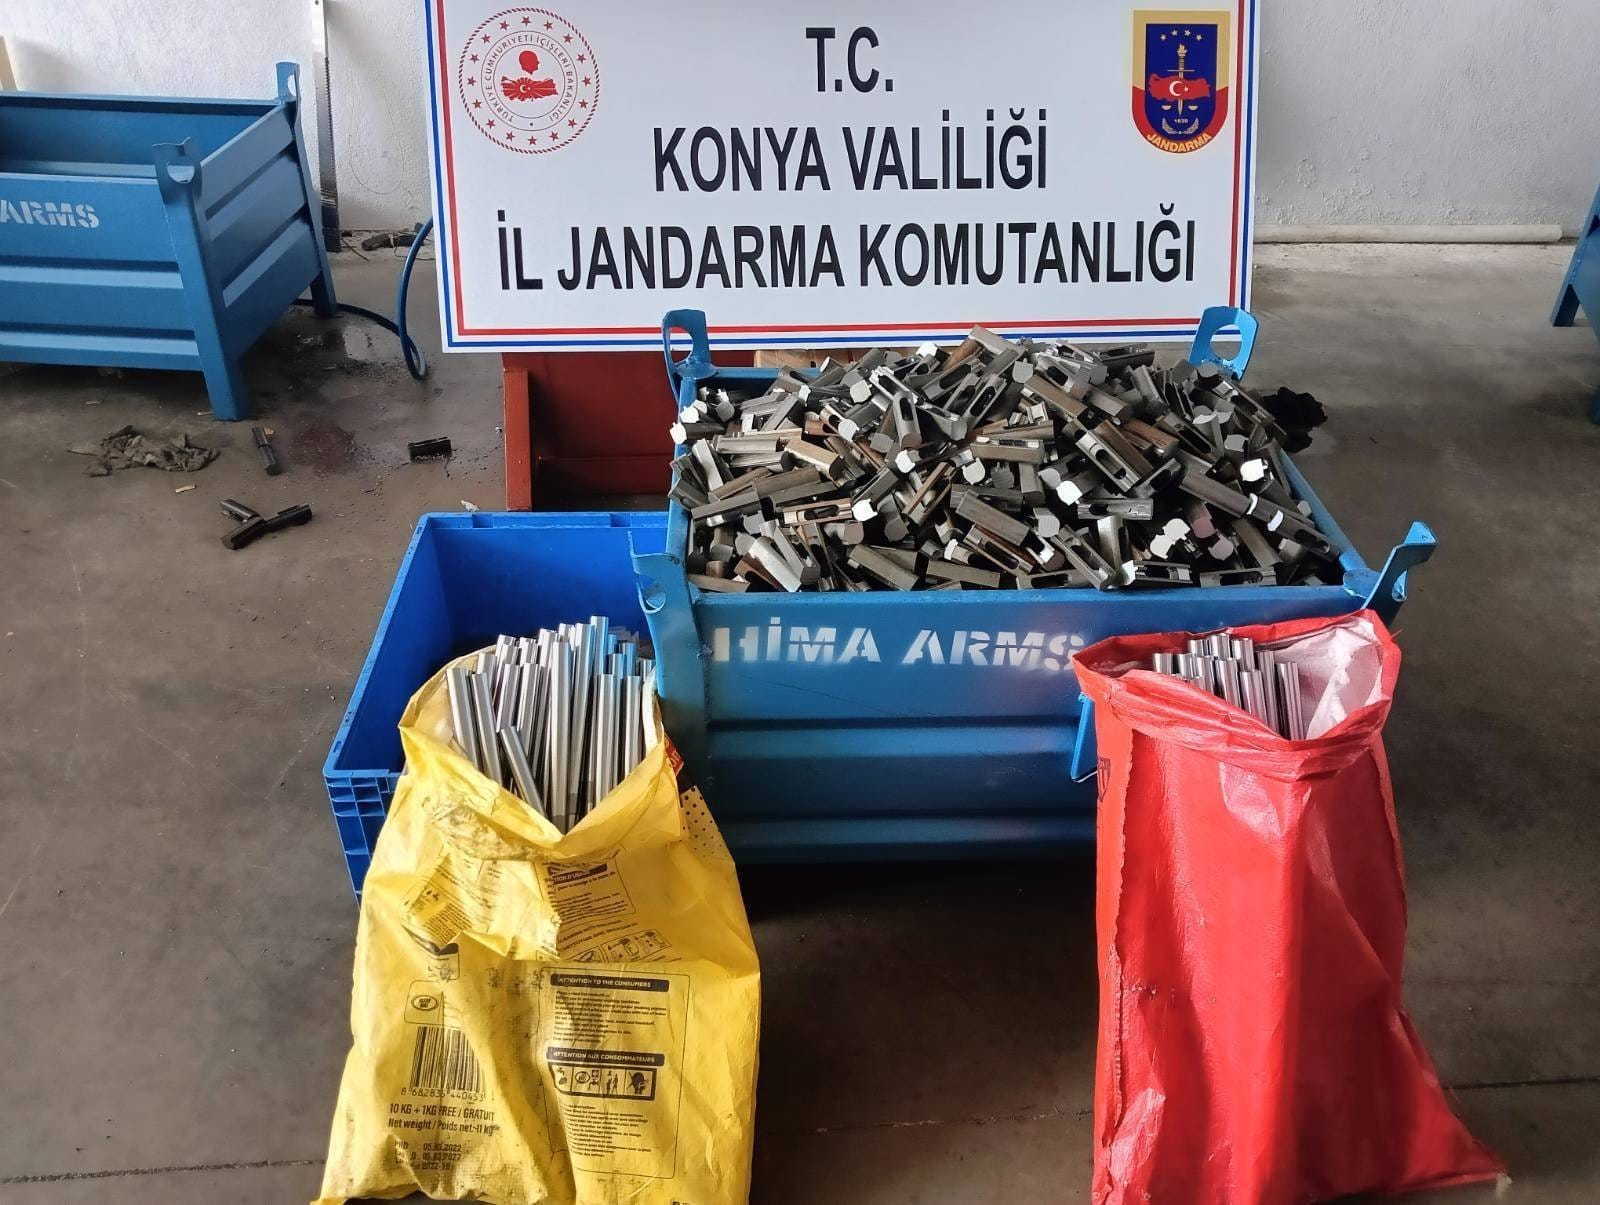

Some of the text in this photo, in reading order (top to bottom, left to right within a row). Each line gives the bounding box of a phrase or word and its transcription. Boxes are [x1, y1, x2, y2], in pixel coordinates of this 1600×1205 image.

[486, 34, 533, 81] CUMHURİYETİ
[806, 26, 893, 93] T.C.
[653, 107, 1047, 192] KONYA VALİLİĞİ
[1146, 132, 1212, 153] JANDARMA
[497, 203, 1195, 291] İL JANDARMA KOMUTANLIĞI
[713, 616, 1086, 673] HİMA ARMS
[559, 976, 592, 984] ATTENTION
[614, 980, 651, 988] CONSUMERS
[553, 1051, 587, 1059] ATTENTION
[601, 1054, 655, 1063] CONSOMMATEURS
[388, 1118, 402, 1128] Net
[403, 1119, 431, 1131] weight
[438, 1121, 458, 1132] Poids
[390, 1103, 399, 1114] 10
[400, 1103, 412, 1114] KG
[422, 1105, 437, 1116] 1KG
[438, 1105, 457, 1117] FREE
[463, 1108, 495, 1121] GRATUIT
